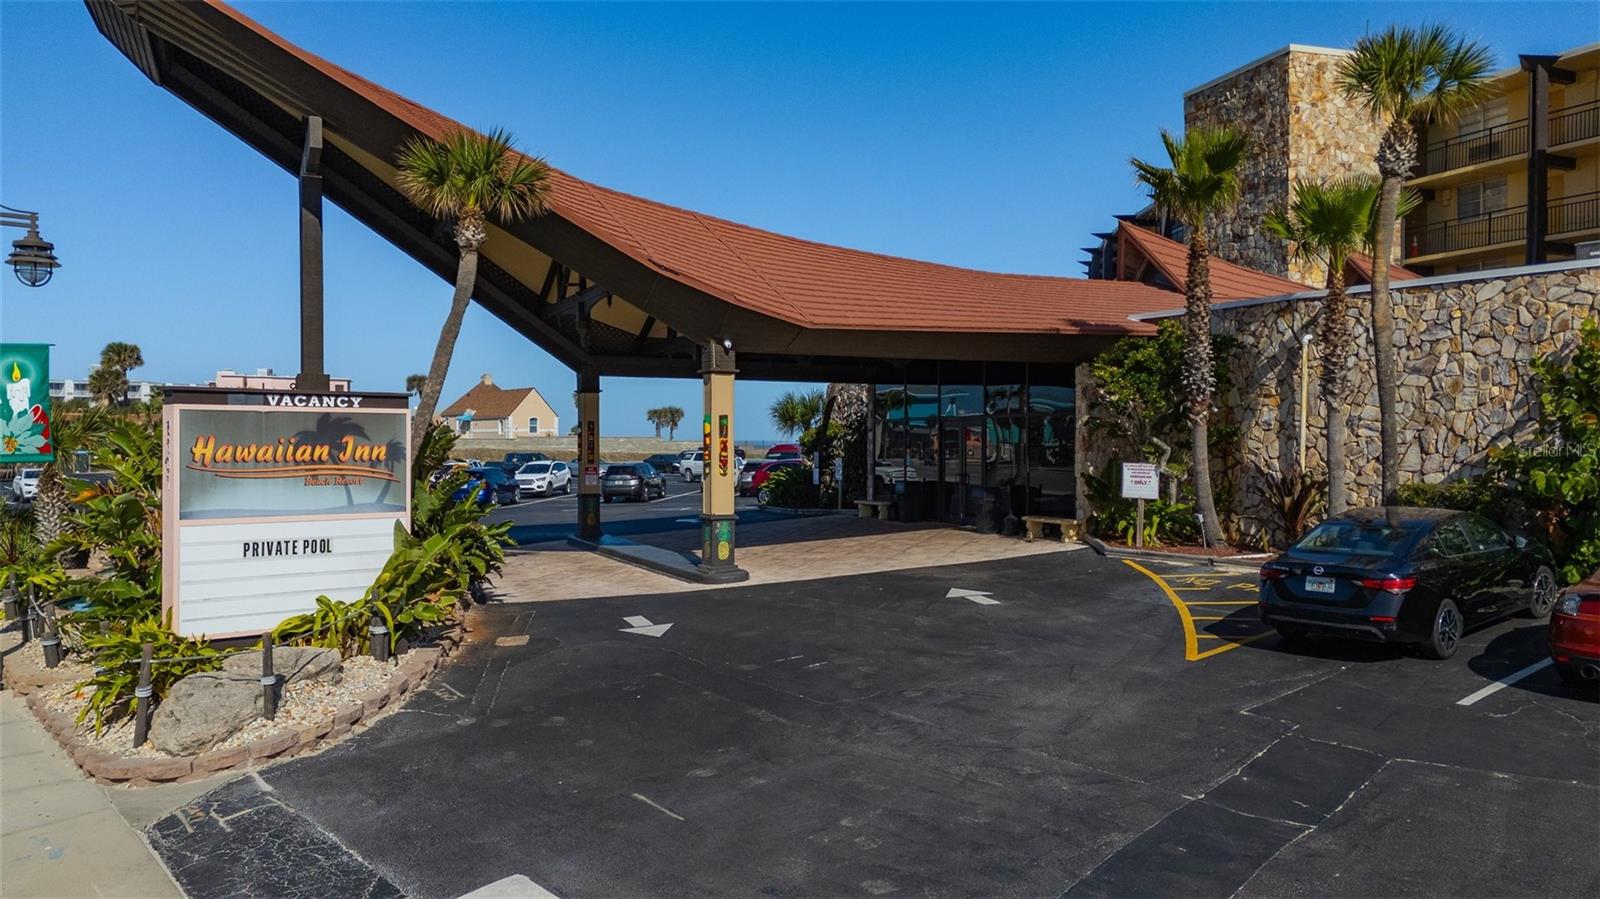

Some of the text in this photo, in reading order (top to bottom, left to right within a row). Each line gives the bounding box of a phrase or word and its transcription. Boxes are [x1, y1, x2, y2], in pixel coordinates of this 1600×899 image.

[266, 394, 363, 408] VACANCY
[191, 435, 330, 467] Hawaiian
[338, 434, 388, 462] Inn
[243, 538, 332, 558] PRIVATE POOL
